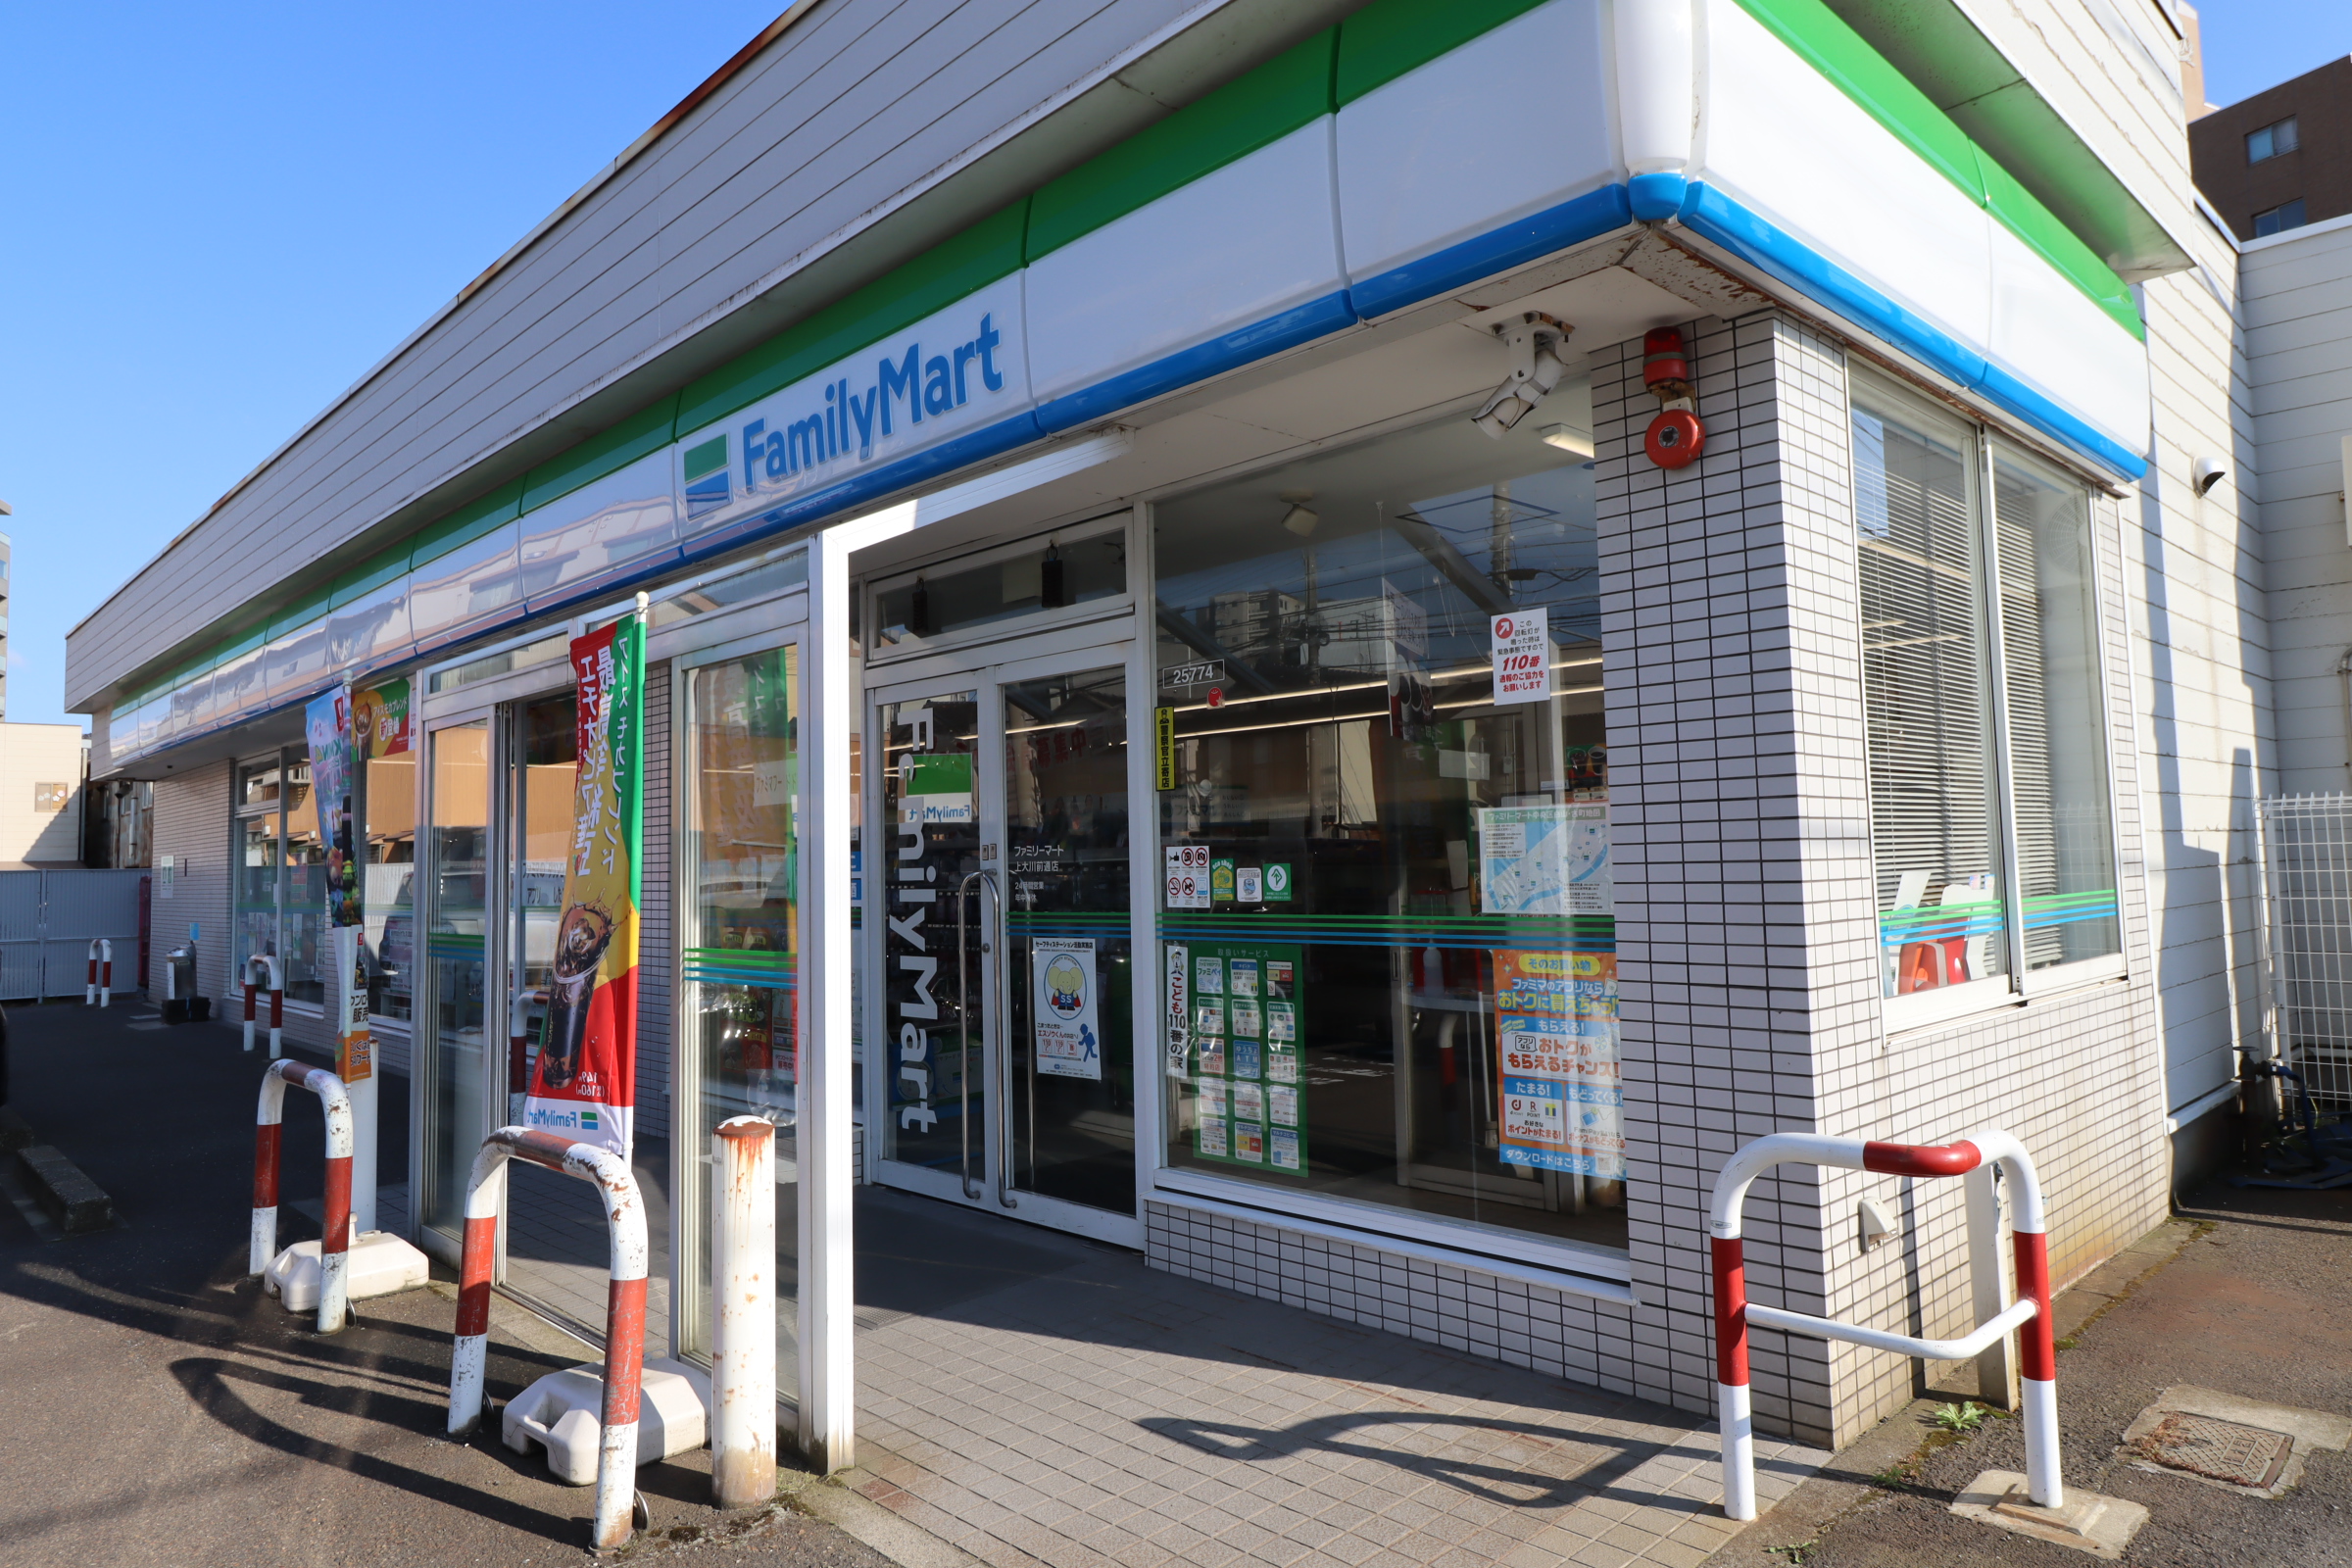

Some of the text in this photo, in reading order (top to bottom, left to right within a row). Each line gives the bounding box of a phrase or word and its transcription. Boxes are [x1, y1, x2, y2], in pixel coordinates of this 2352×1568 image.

[742, 311, 1004, 496] FamilyMart
[1514, 626, 1541, 637] 回転灯が
[1510, 635, 1541, 646] 鳴った時は
[1497, 643, 1544, 656] 緊急事態ですので
[1502, 655, 1541, 671] 110番
[1173, 664, 1213, 684] 25774
[1498, 670, 1544, 683] 通報のご協力を
[1502, 680, 1543, 692] お願いします
[1013, 844, 1064, 857] ファミリーマート
[1014, 860, 1059, 872] 上大川前通店
[1217, 948, 1269, 957] 取扱いサービス
[1529, 958, 1592, 972] そのお買い物
[1512, 978, 1604, 995] ファミマのアプリなら
[1539, 1019, 1585, 1034] もらえる!
[1539, 1038, 1592, 1056] おトクが
[1508, 1053, 1620, 1078] もらえるチャンス!
[1516, 1081, 1550, 1096] たまる!
[1569, 1088, 1623, 1104] もどってくる!
[1508, 1124, 1561, 1140] ポイントがたまる!
[1506, 1149, 1591, 1170] ダウンロードはこちら
